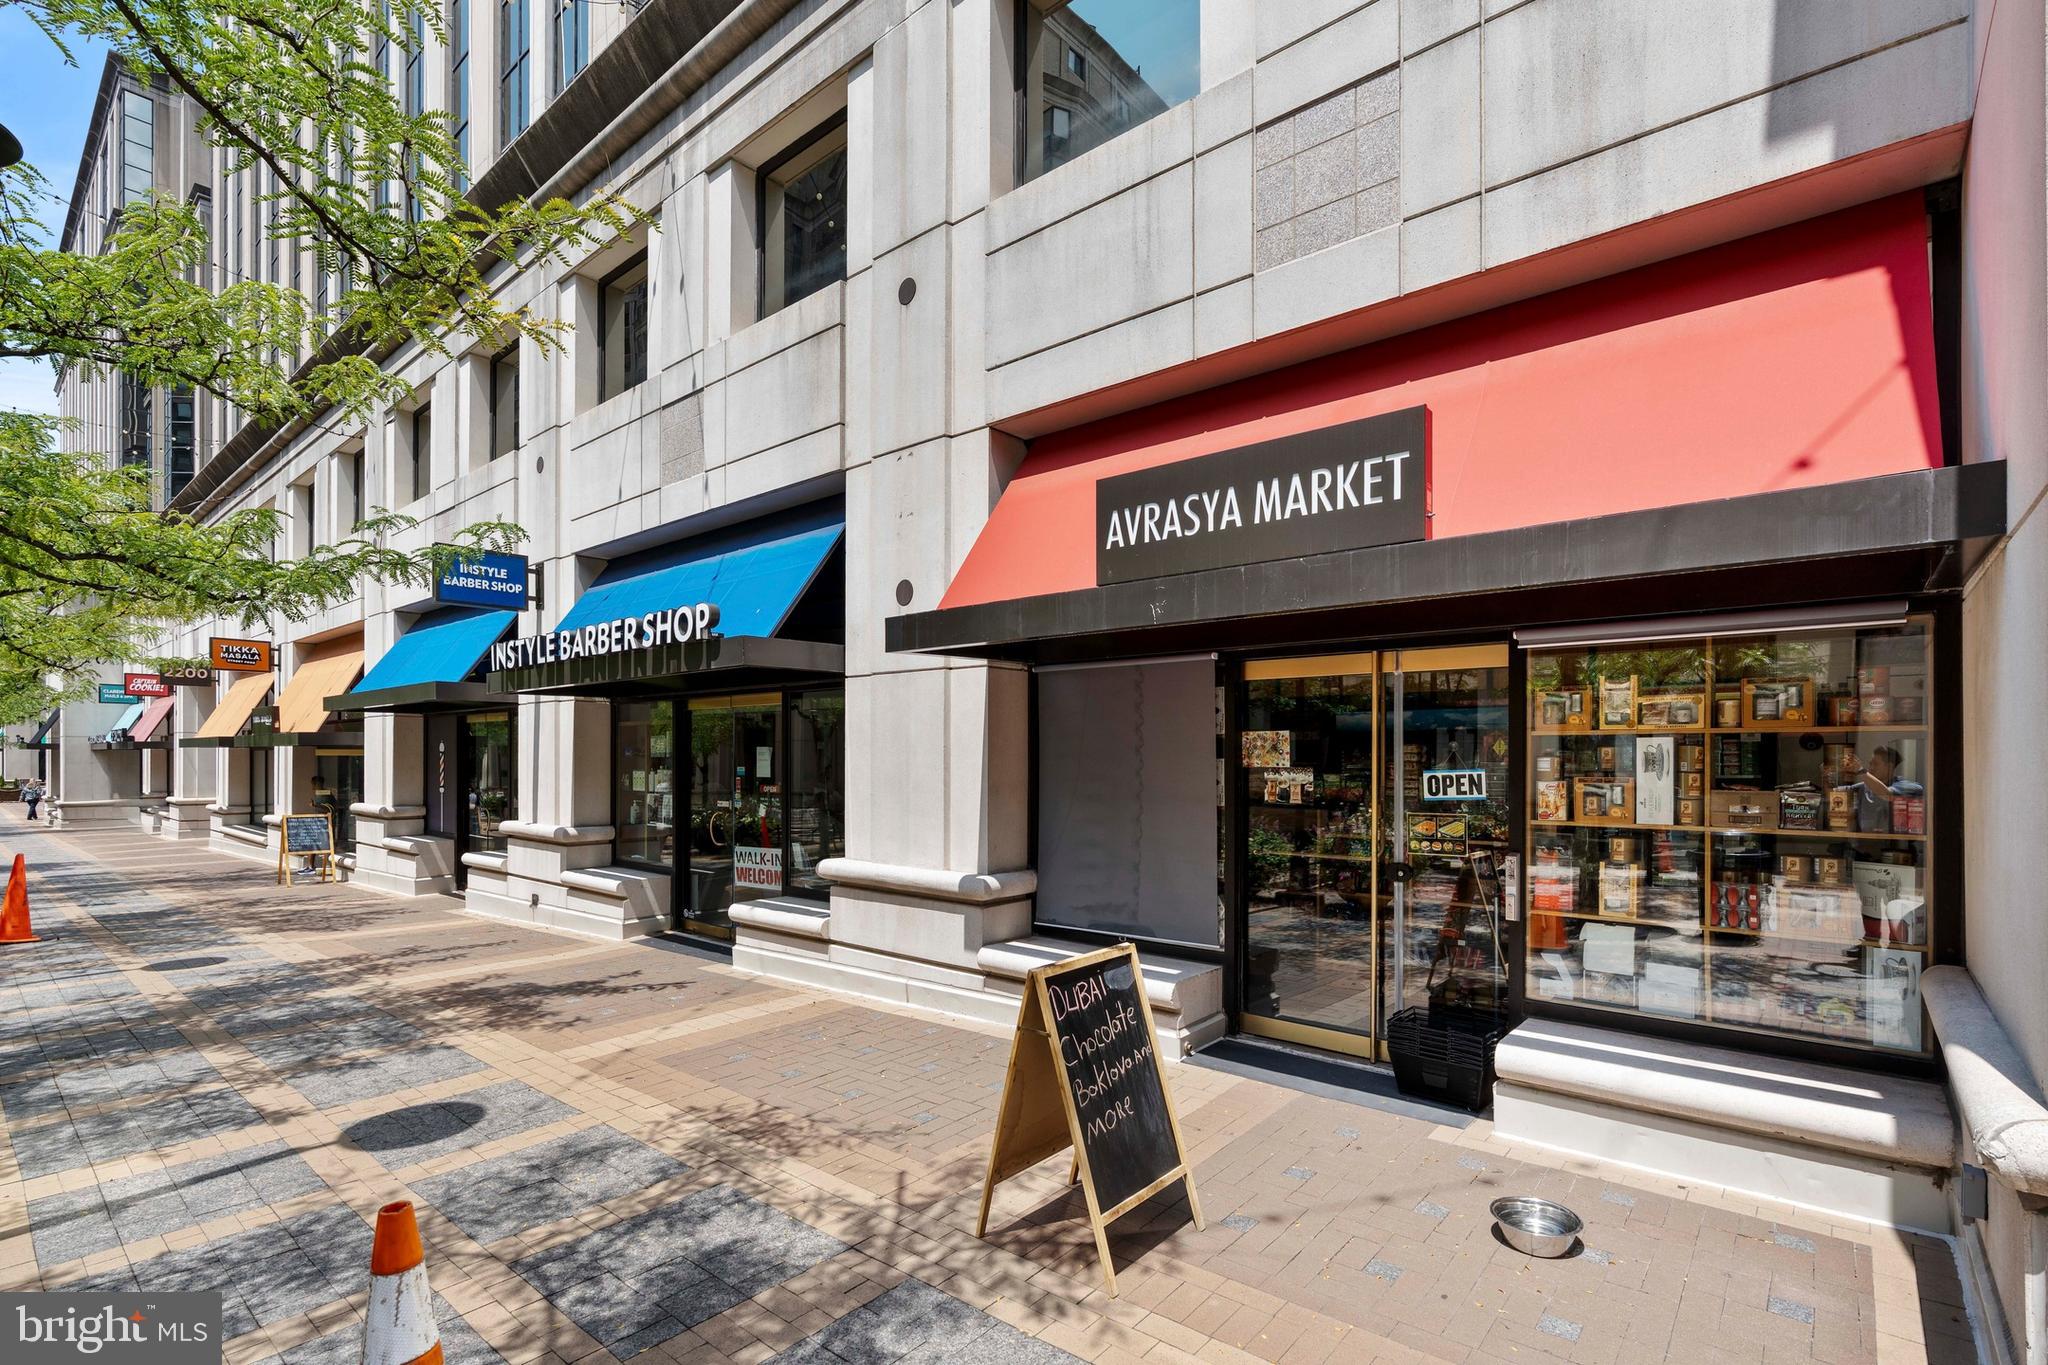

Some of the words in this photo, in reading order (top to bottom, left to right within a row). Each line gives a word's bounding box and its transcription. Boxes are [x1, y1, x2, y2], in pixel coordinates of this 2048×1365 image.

[1106, 486, 1242, 550] AVRASYA
[1253, 451, 1410, 525] MARKET
[460, 562, 508, 579] INSTYLE
[443, 574, 490, 590] BARBER
[491, 581, 523, 594] SHOP
[490, 632, 556, 671] INSTYLE
[560, 617, 638, 661] BARBER
[642, 602, 711, 648] SHOP
[220, 644, 259, 654] TIKKA
[220, 652, 260, 660] MASALA
[164, 667, 208, 679] 2200
[129, 683, 165, 692] COOKIE!
[763, 785, 777, 793] OPEN
[1427, 773, 1483, 797] OPEN
[1060, 1000, 1137, 1067] Chocolate
